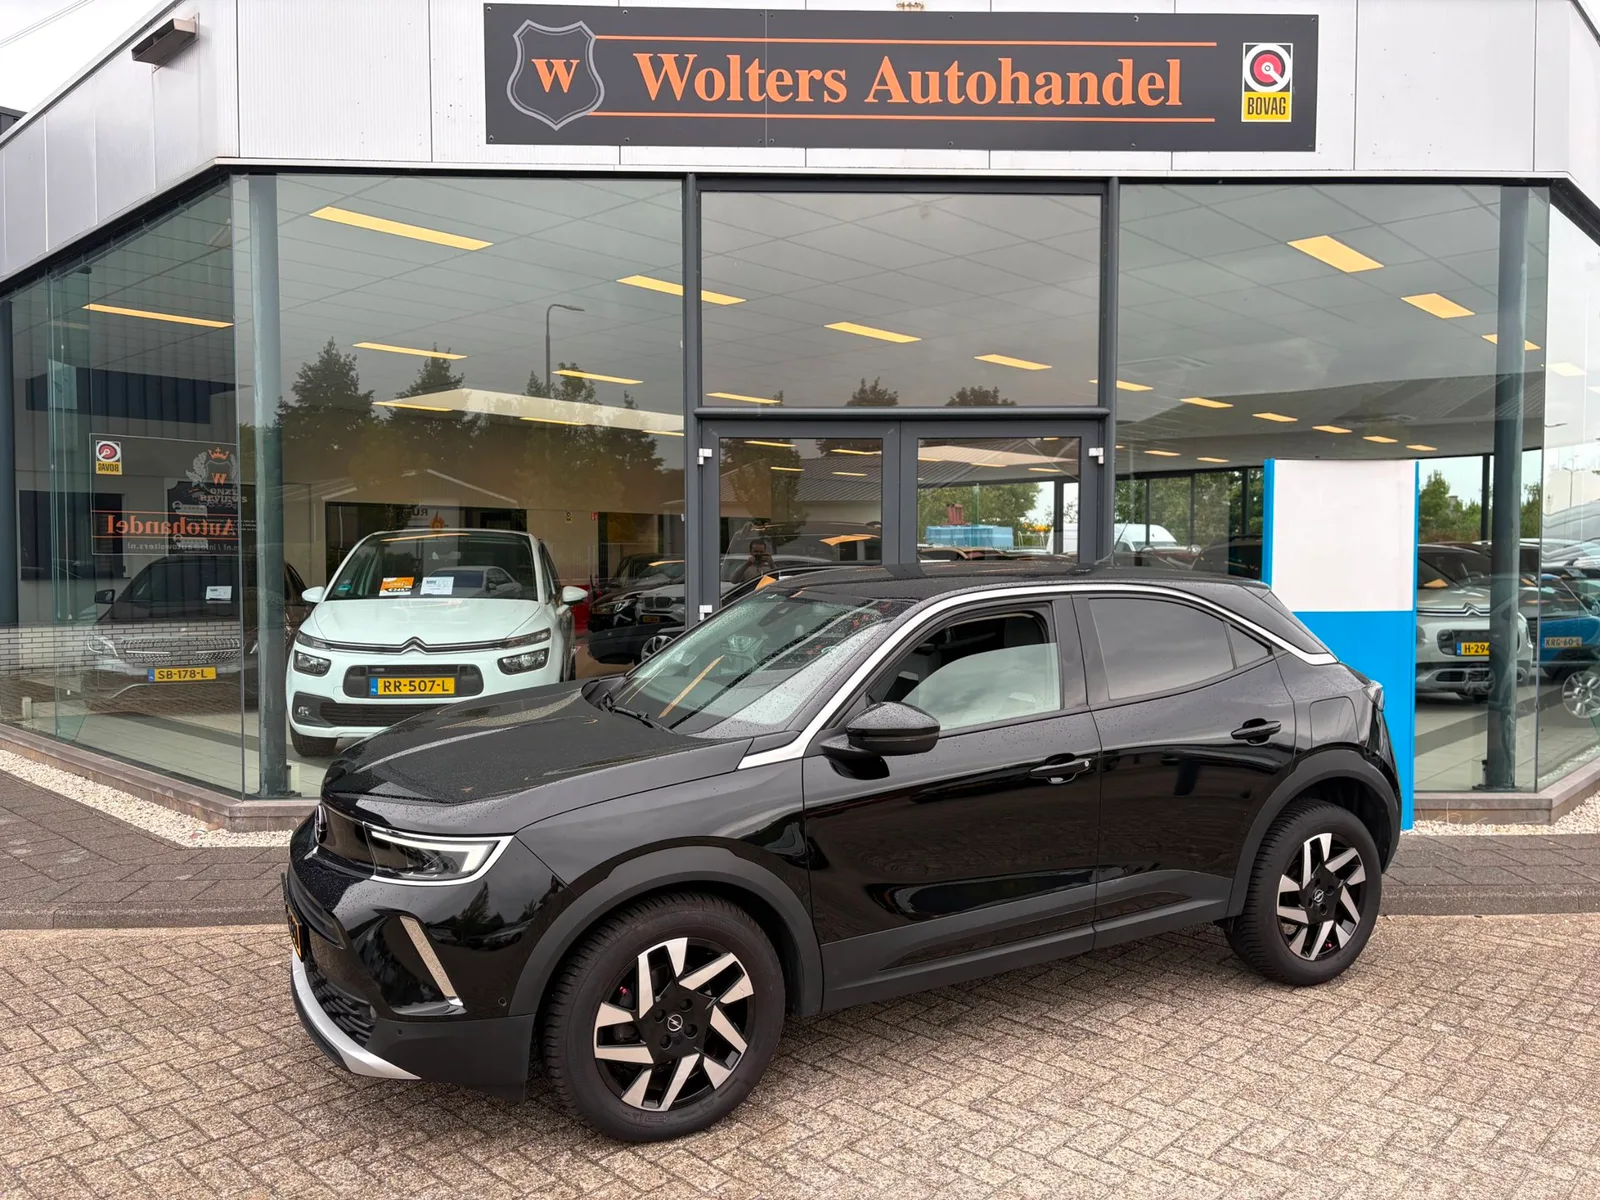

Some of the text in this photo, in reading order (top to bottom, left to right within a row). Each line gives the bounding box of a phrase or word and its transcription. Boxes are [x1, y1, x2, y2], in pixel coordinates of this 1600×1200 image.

[531, 58, 580, 93] W
[632, 52, 1183, 107] Wolters Autohandel
[1247, 96, 1287, 117] BOVAG
[158, 669, 208, 680] SB-178-L
[383, 680, 450, 693] RR-507-L
